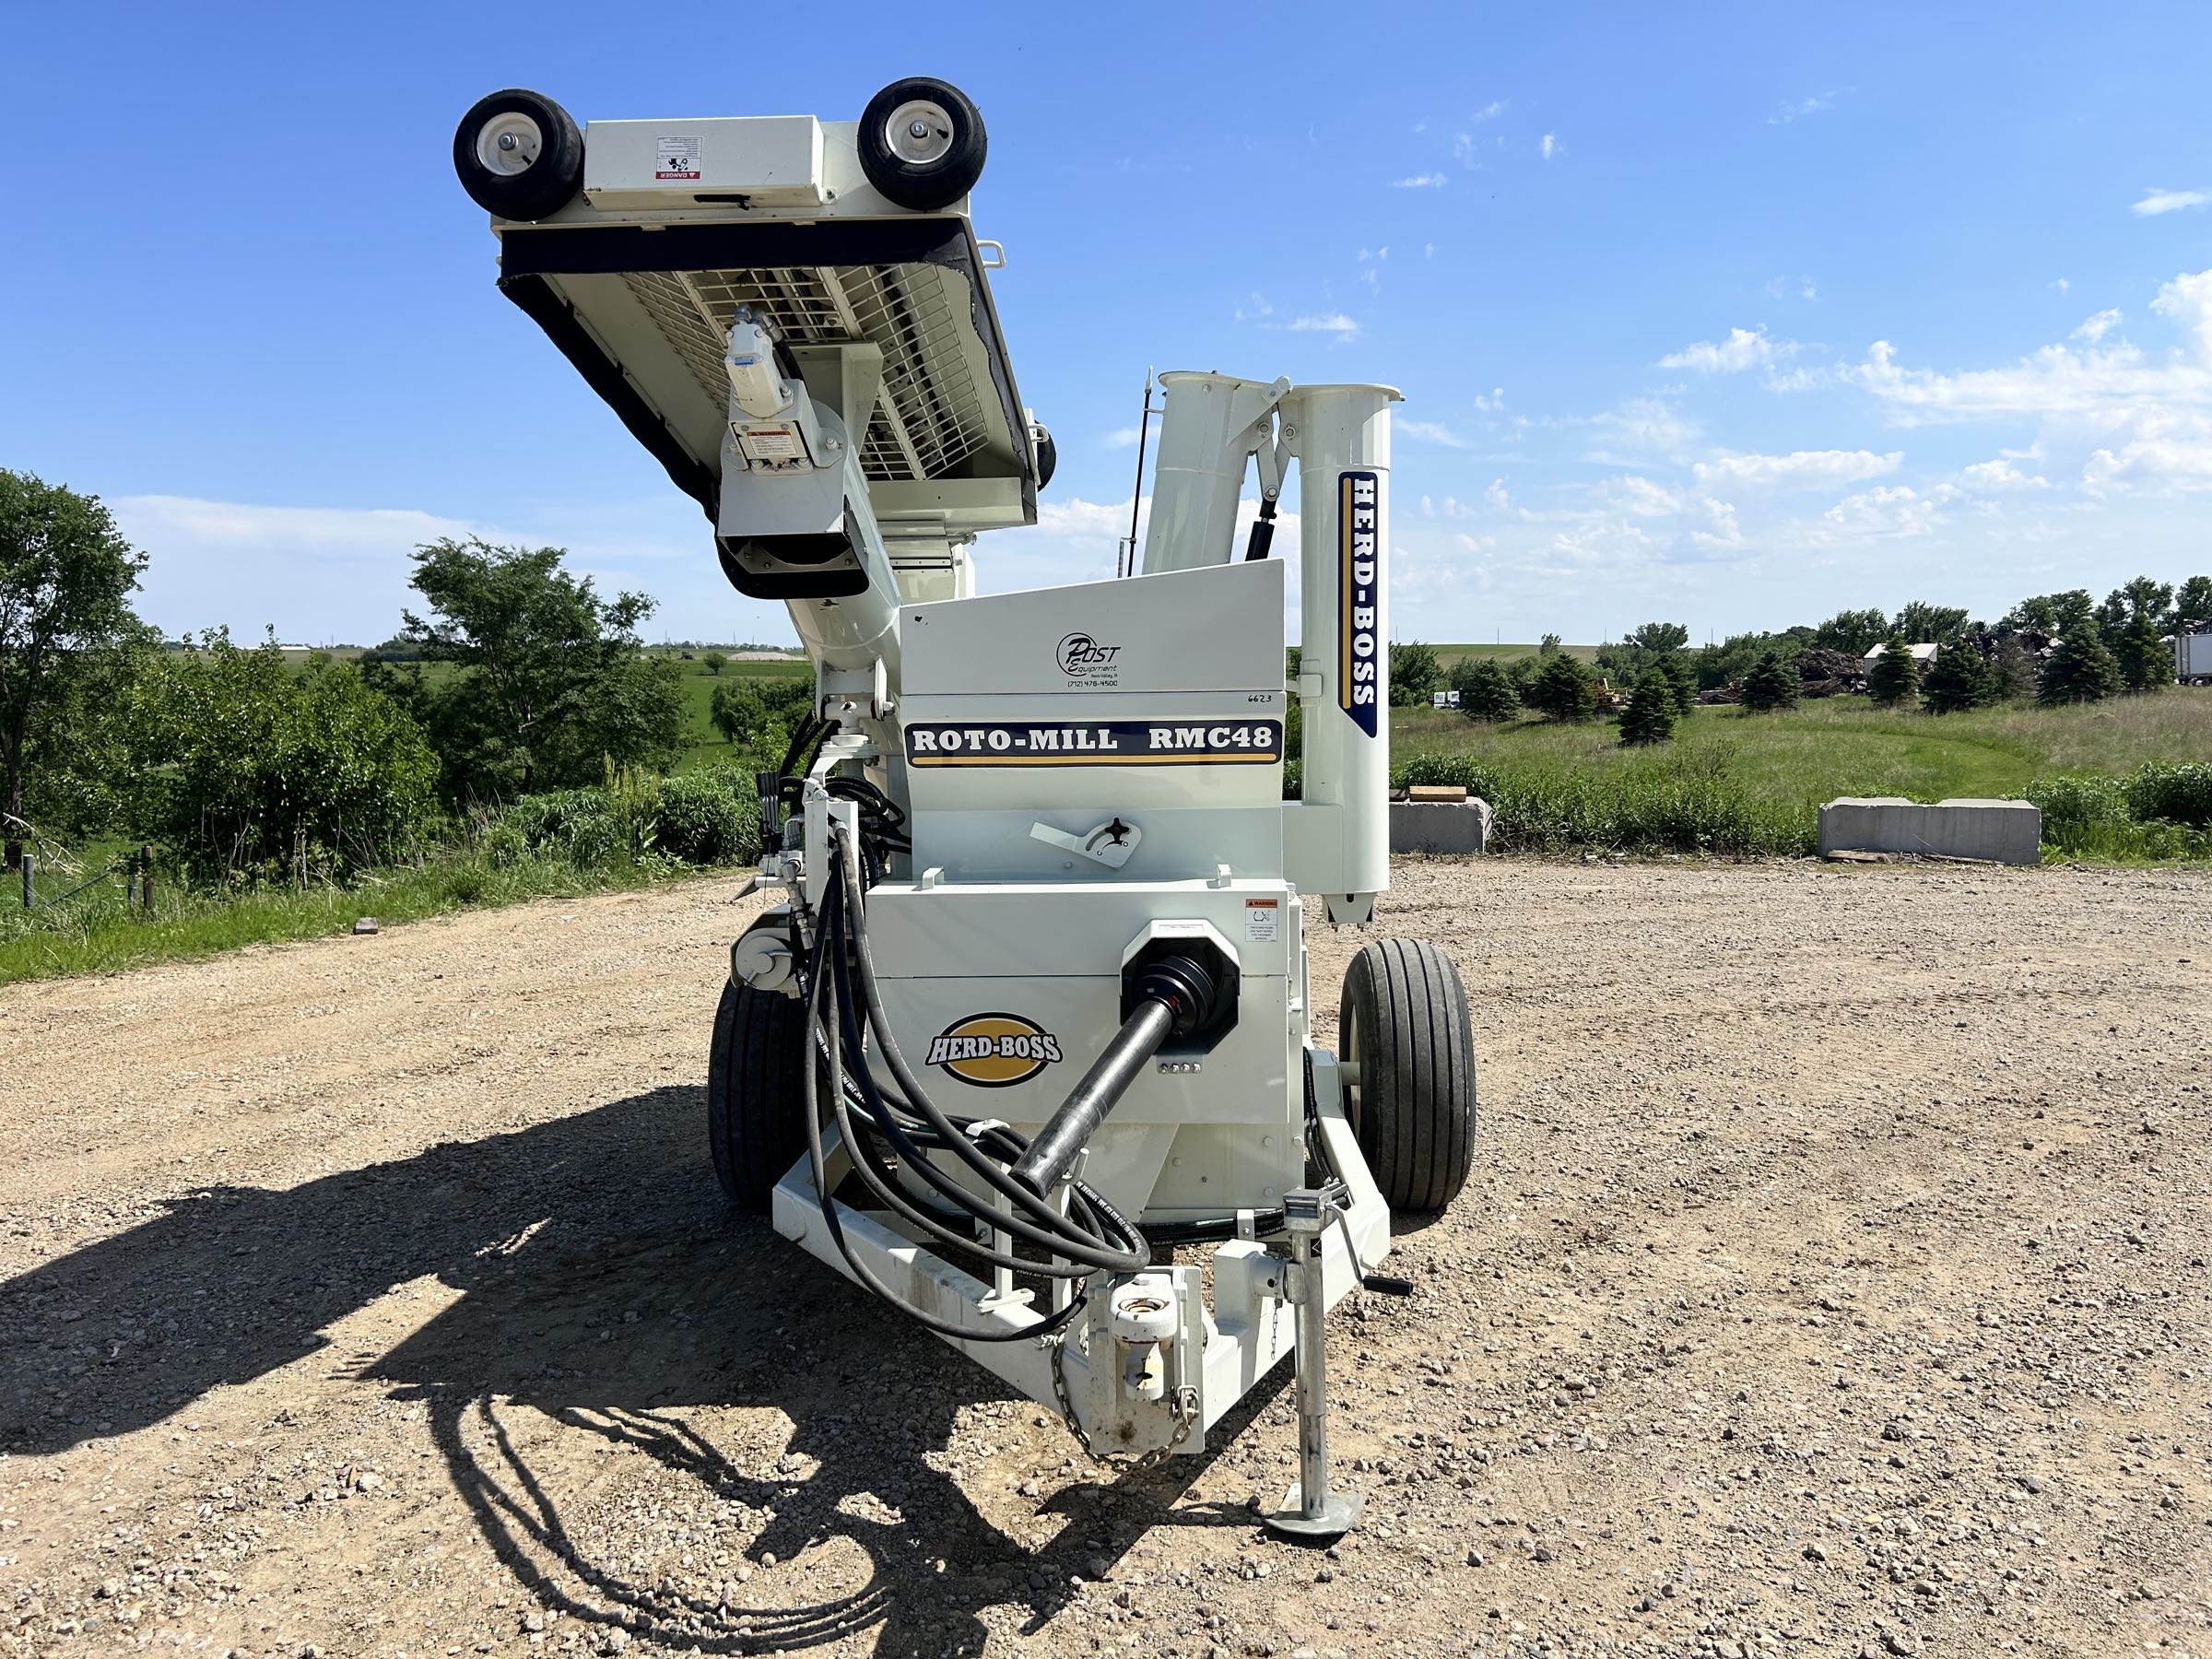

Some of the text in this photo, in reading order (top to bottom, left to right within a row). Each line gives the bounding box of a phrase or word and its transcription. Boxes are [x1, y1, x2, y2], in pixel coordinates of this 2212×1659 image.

[1353, 478, 1374, 705] HERD-BOSS
[1067, 658, 1117, 673] Equipment
[1248, 694, 1272, 703] 6623
[913, 726, 1273, 751] ROTO-MILL RMC48
[927, 1035, 1061, 1064] HERD-BOSS
